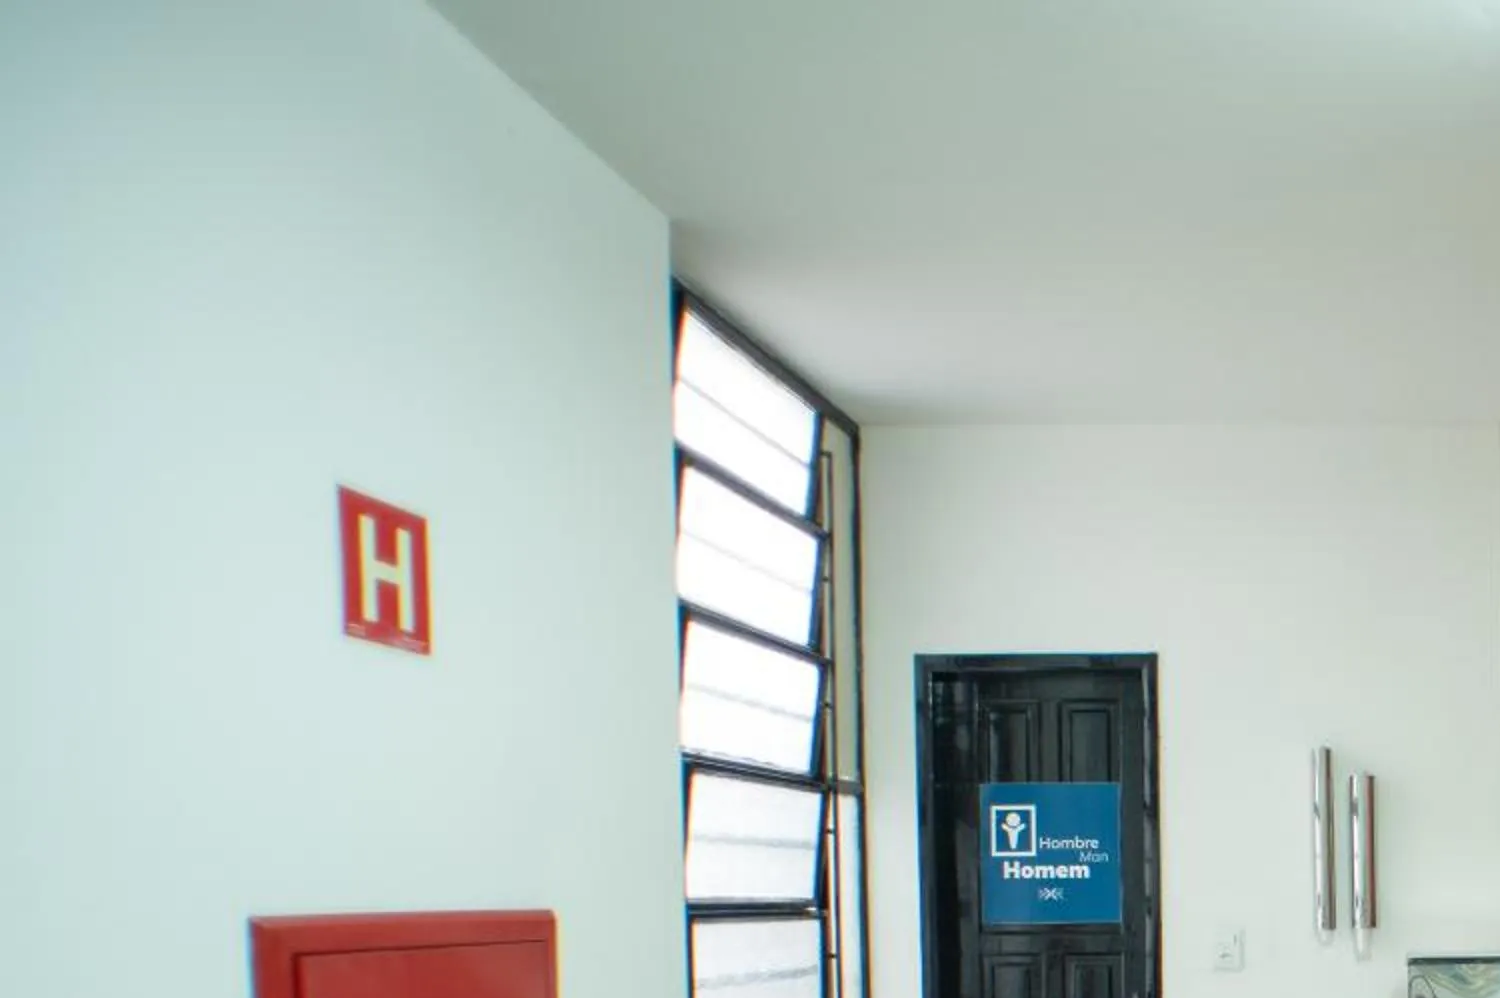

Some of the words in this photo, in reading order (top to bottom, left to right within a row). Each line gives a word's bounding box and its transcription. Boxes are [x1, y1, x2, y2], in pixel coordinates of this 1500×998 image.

[358, 513, 414, 632] H
[1039, 835, 1099, 849] Hombre
[1079, 851, 1109, 862] Man
[1003, 861, 1091, 879] Homem
